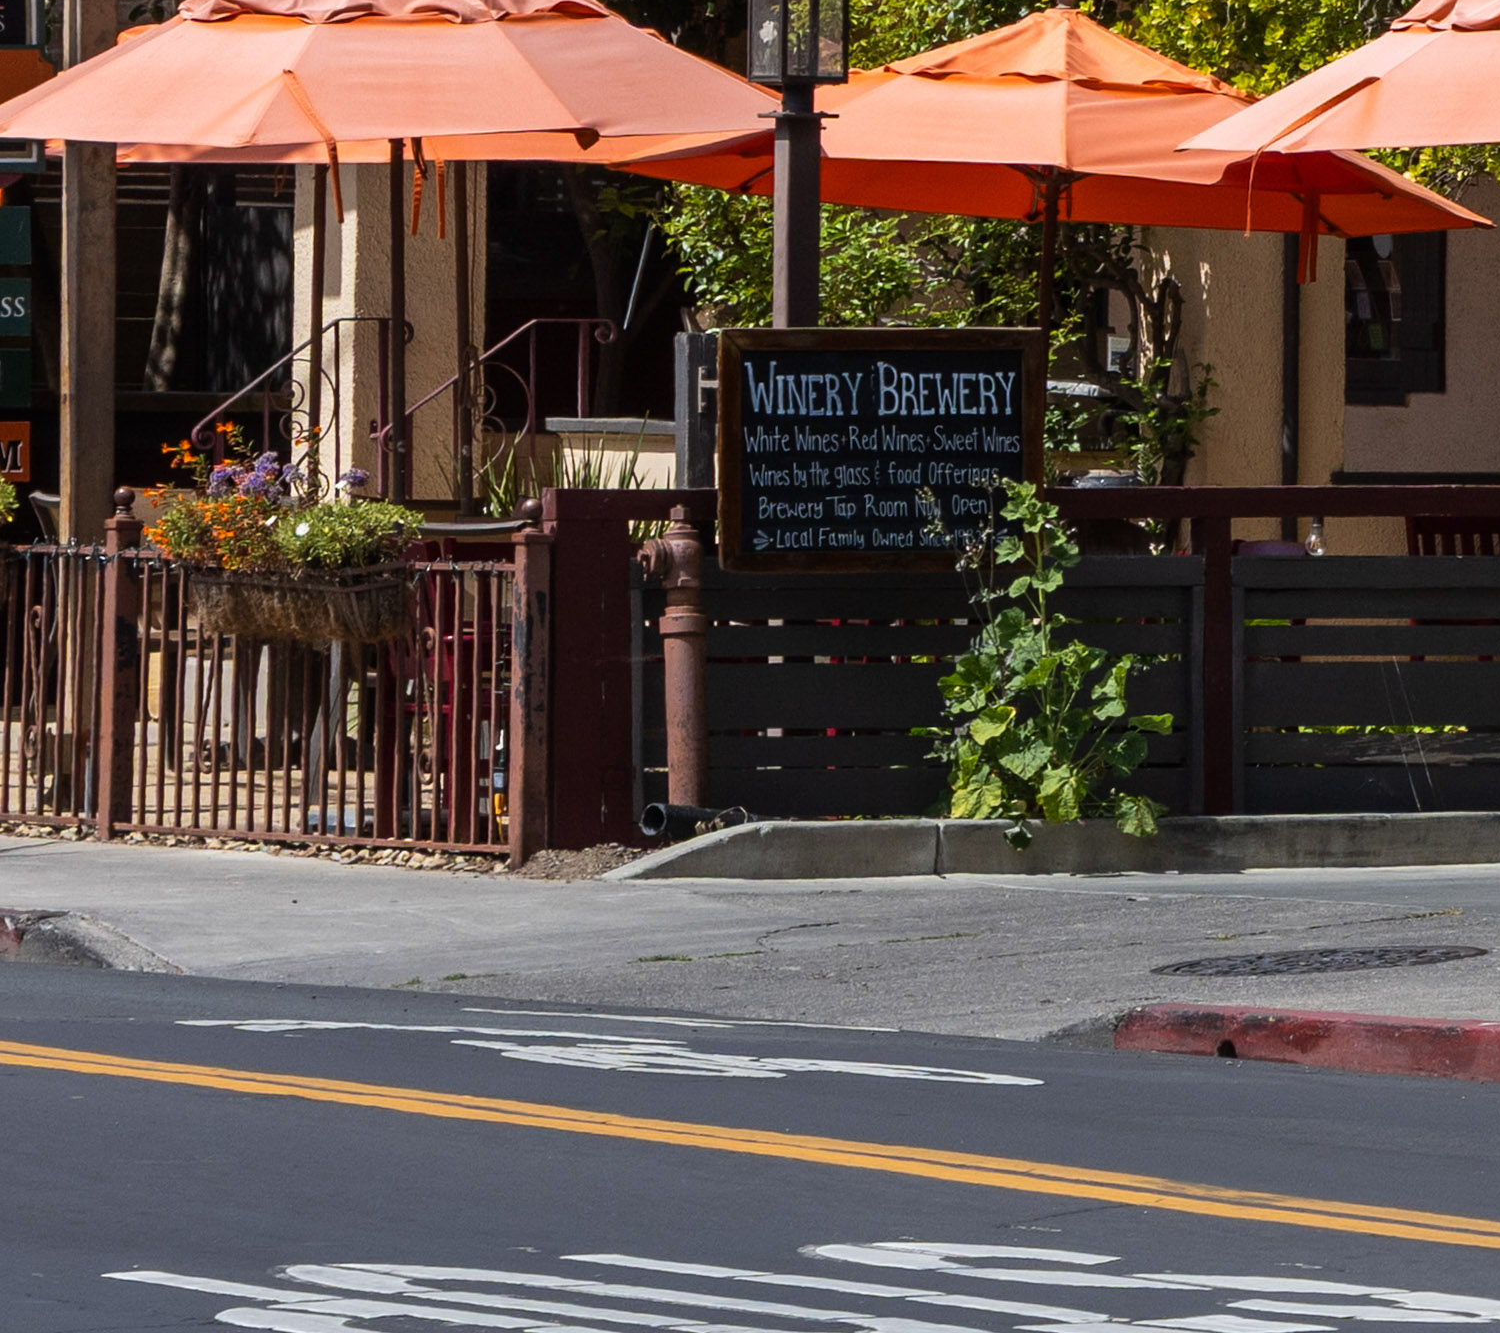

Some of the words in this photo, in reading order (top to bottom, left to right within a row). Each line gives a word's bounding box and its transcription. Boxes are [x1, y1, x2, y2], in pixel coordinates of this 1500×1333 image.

[744, 361, 863, 416] WINERY
[877, 361, 1016, 416] BREWERY
[744, 425, 790, 453] White
[794, 425, 839, 453] Wines
[848, 425, 877, 450] Red
[881, 425, 926, 453] Wines
[933, 425, 979, 451] Sweet
[982, 426, 1020, 453] Wines
[749, 463, 791, 487] Wines
[793, 462, 807, 488] by
[809, 461, 830, 487] the
[834, 465, 871, 489] glass
[888, 461, 922, 485] food
[928, 461, 1000, 488] Offerings
[758, 495, 823, 519] Brewery
[825, 495, 856, 519] Tap
[864, 494, 908, 517] Room
[952, 494, 987, 515] Open
[777, 528, 814, 549] Local
[818, 528, 864, 549] Family
[872, 529, 913, 548] Owned
